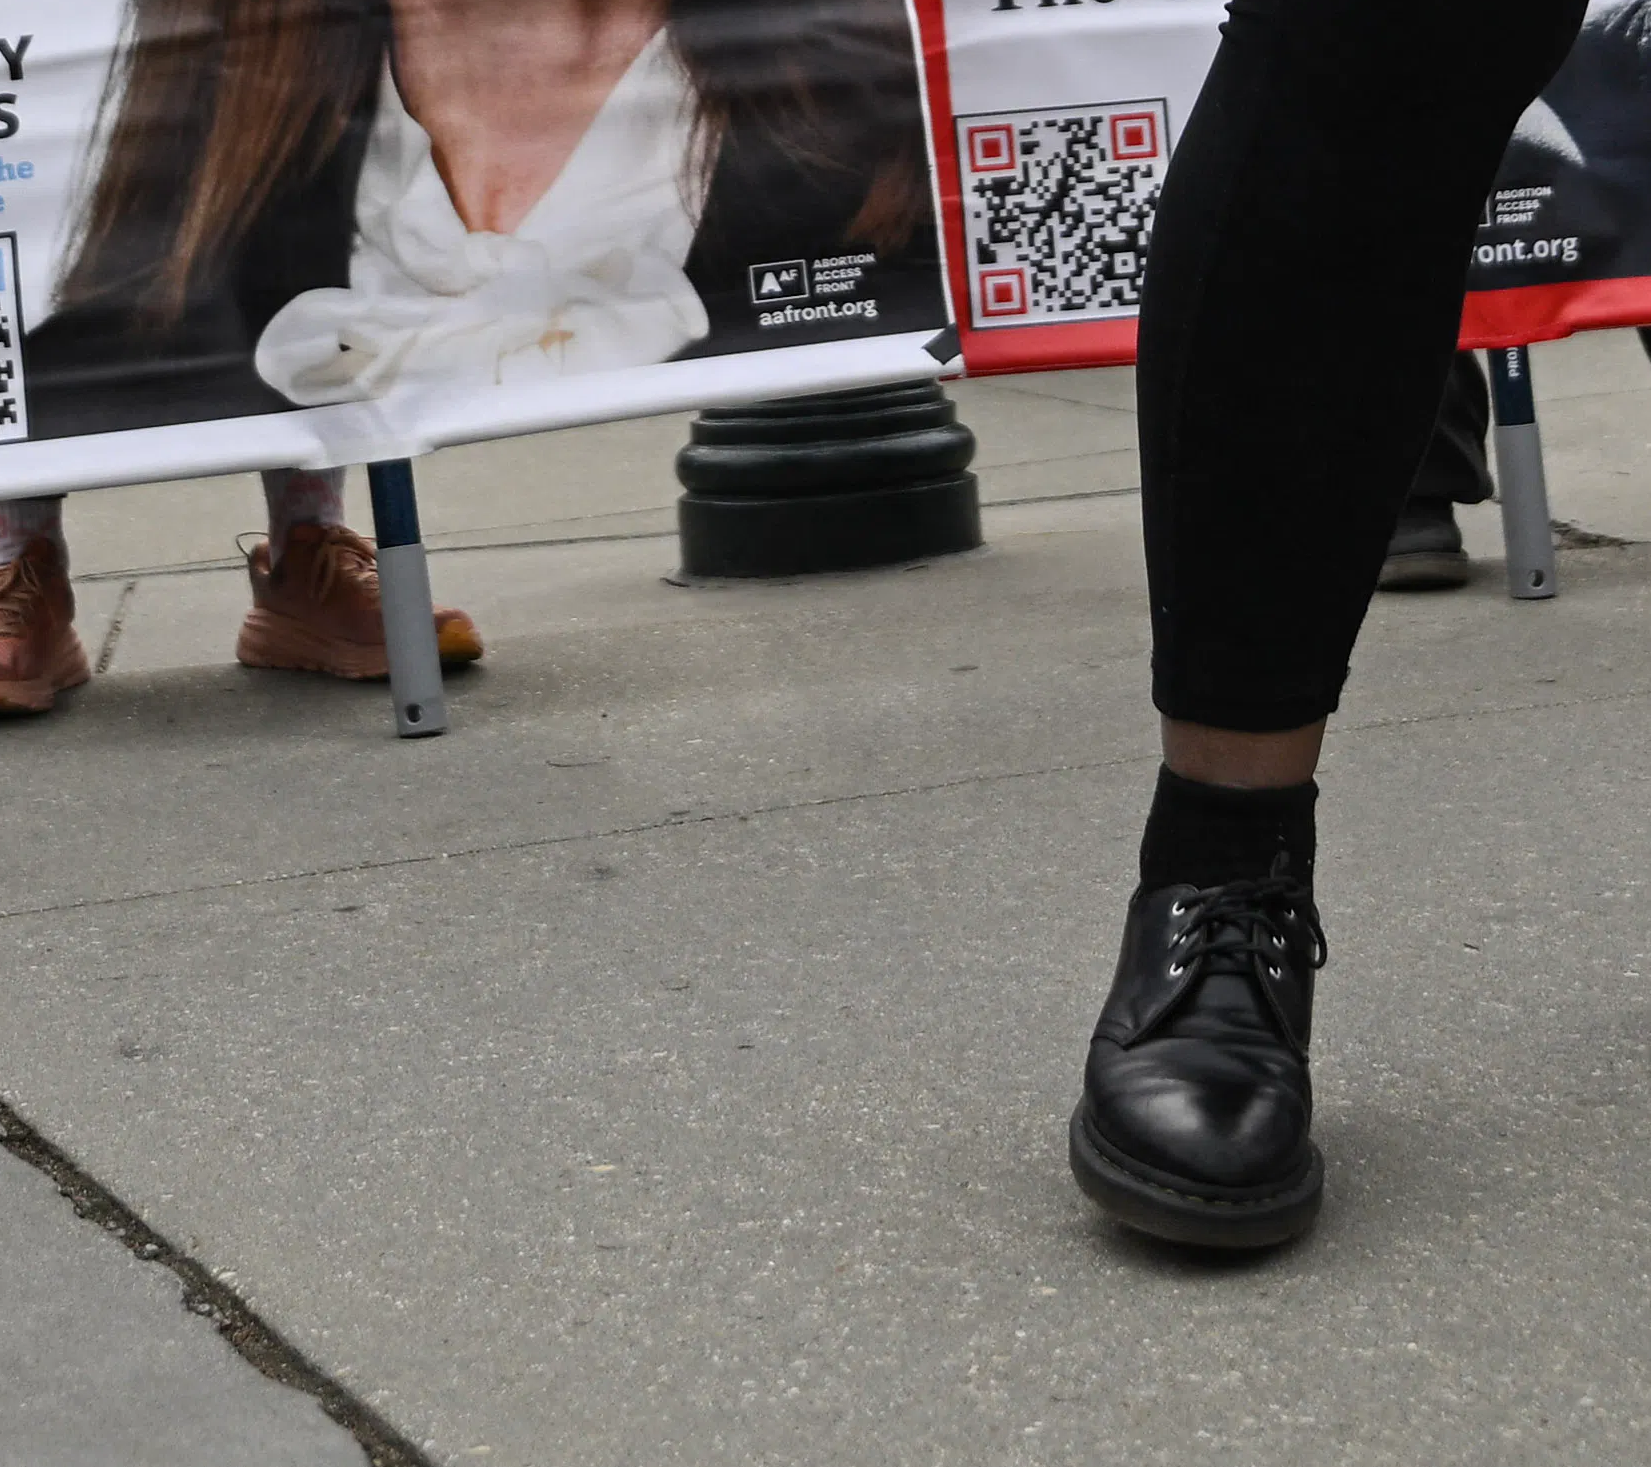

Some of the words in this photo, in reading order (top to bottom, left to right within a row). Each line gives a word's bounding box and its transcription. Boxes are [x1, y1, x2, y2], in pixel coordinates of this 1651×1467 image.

[1495, 186, 1552, 199] ABORTION
[1496, 199, 1540, 212] ACCESS
[1496, 212, 1534, 223] FRONT
[1470, 237, 1578, 263] ont.org
[813, 252, 875, 268] ABORTION
[814, 267, 862, 281] ACCESS
[815, 280, 856, 294] FRONT
[759, 298, 879, 327] aafront.org
